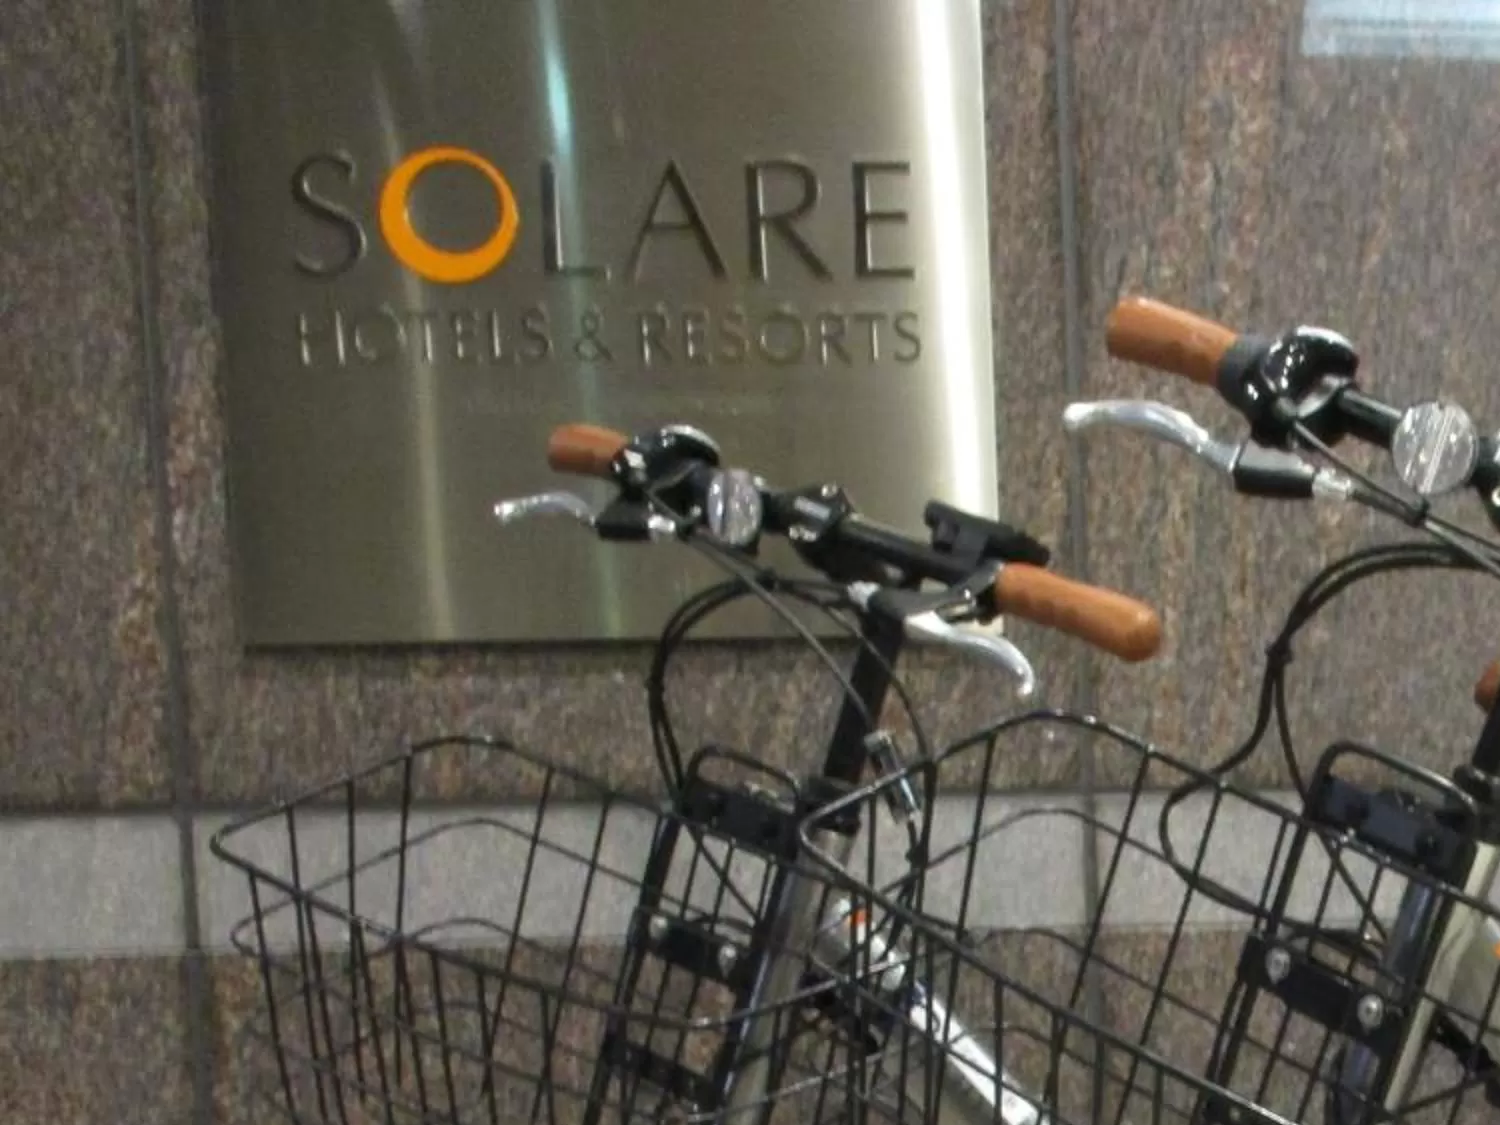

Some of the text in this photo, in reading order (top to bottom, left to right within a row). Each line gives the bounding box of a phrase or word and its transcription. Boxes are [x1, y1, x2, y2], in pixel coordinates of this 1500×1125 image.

[290, 146, 915, 283] SOLARE
[298, 309, 924, 369] HOTELS & RESORTS
